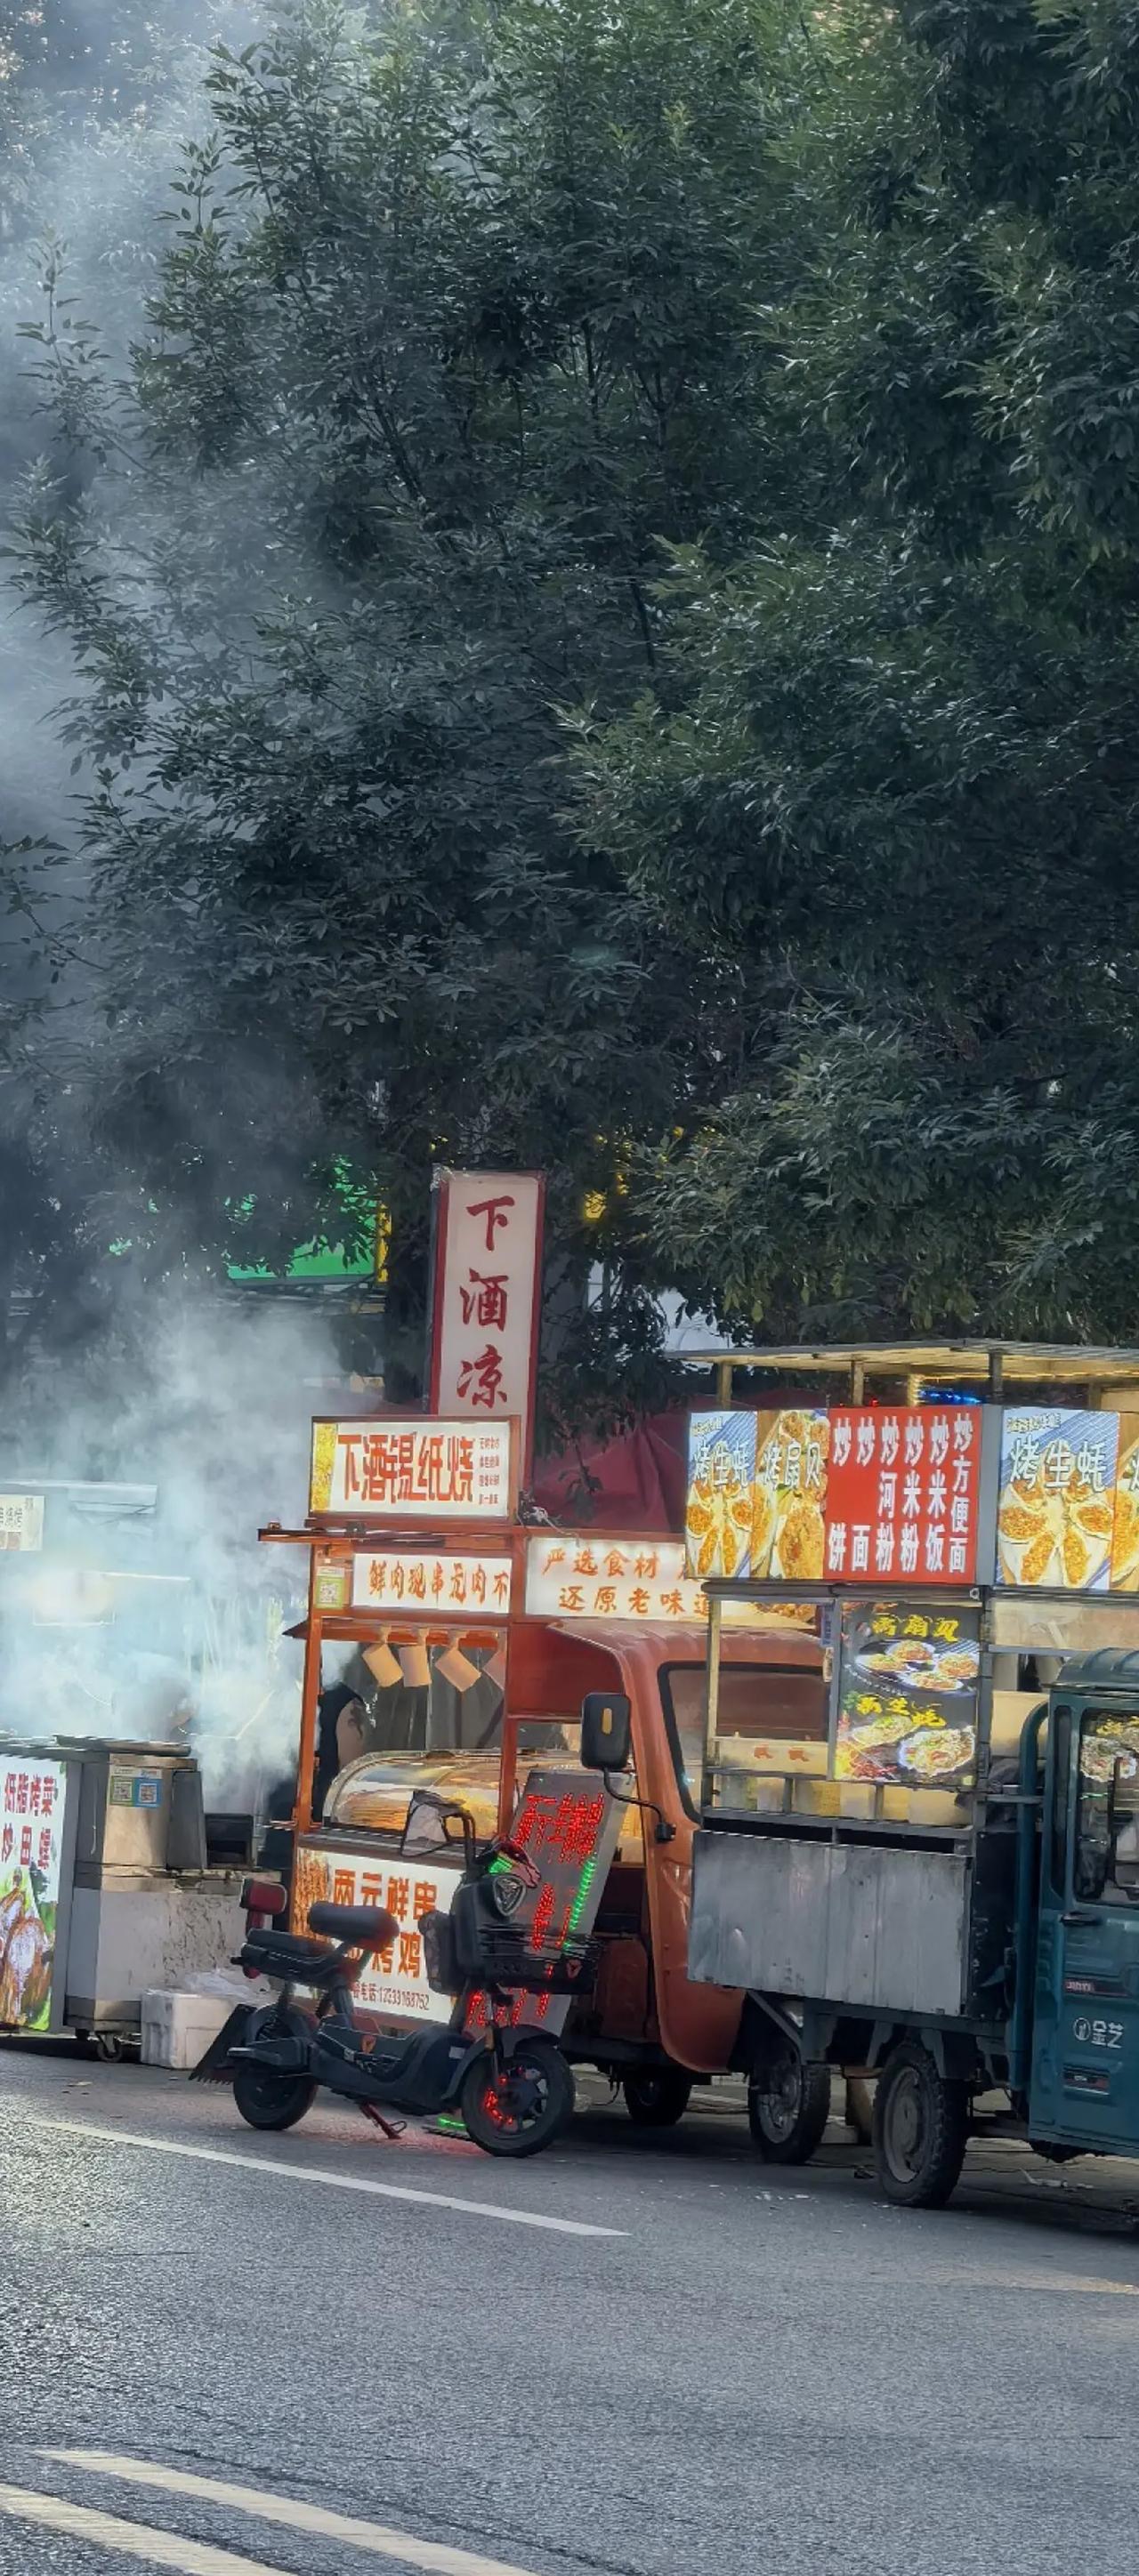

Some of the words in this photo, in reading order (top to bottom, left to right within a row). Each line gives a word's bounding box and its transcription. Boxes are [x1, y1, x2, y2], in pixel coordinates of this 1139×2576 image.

[456, 1195, 515, 1409] 下酒凉
[337, 1432, 475, 1503] 下酒锡纸烧
[695, 1437, 749, 1489] 烤生蚝
[763, 1441, 820, 1491] 烤扇贝
[852, 1416, 876, 1572] 炒面
[876, 1415, 901, 1573] 炒河粉
[900, 1415, 925, 1573] 炒米粉
[925, 1414, 949, 1573] 炒米饭
[949, 1413, 974, 1574] 炒方便面
[1010, 1433, 1107, 1493] 烤生蚝
[542, 1547, 660, 1580] 严选食材
[1091, 2020, 1124, 2049] 金艺
